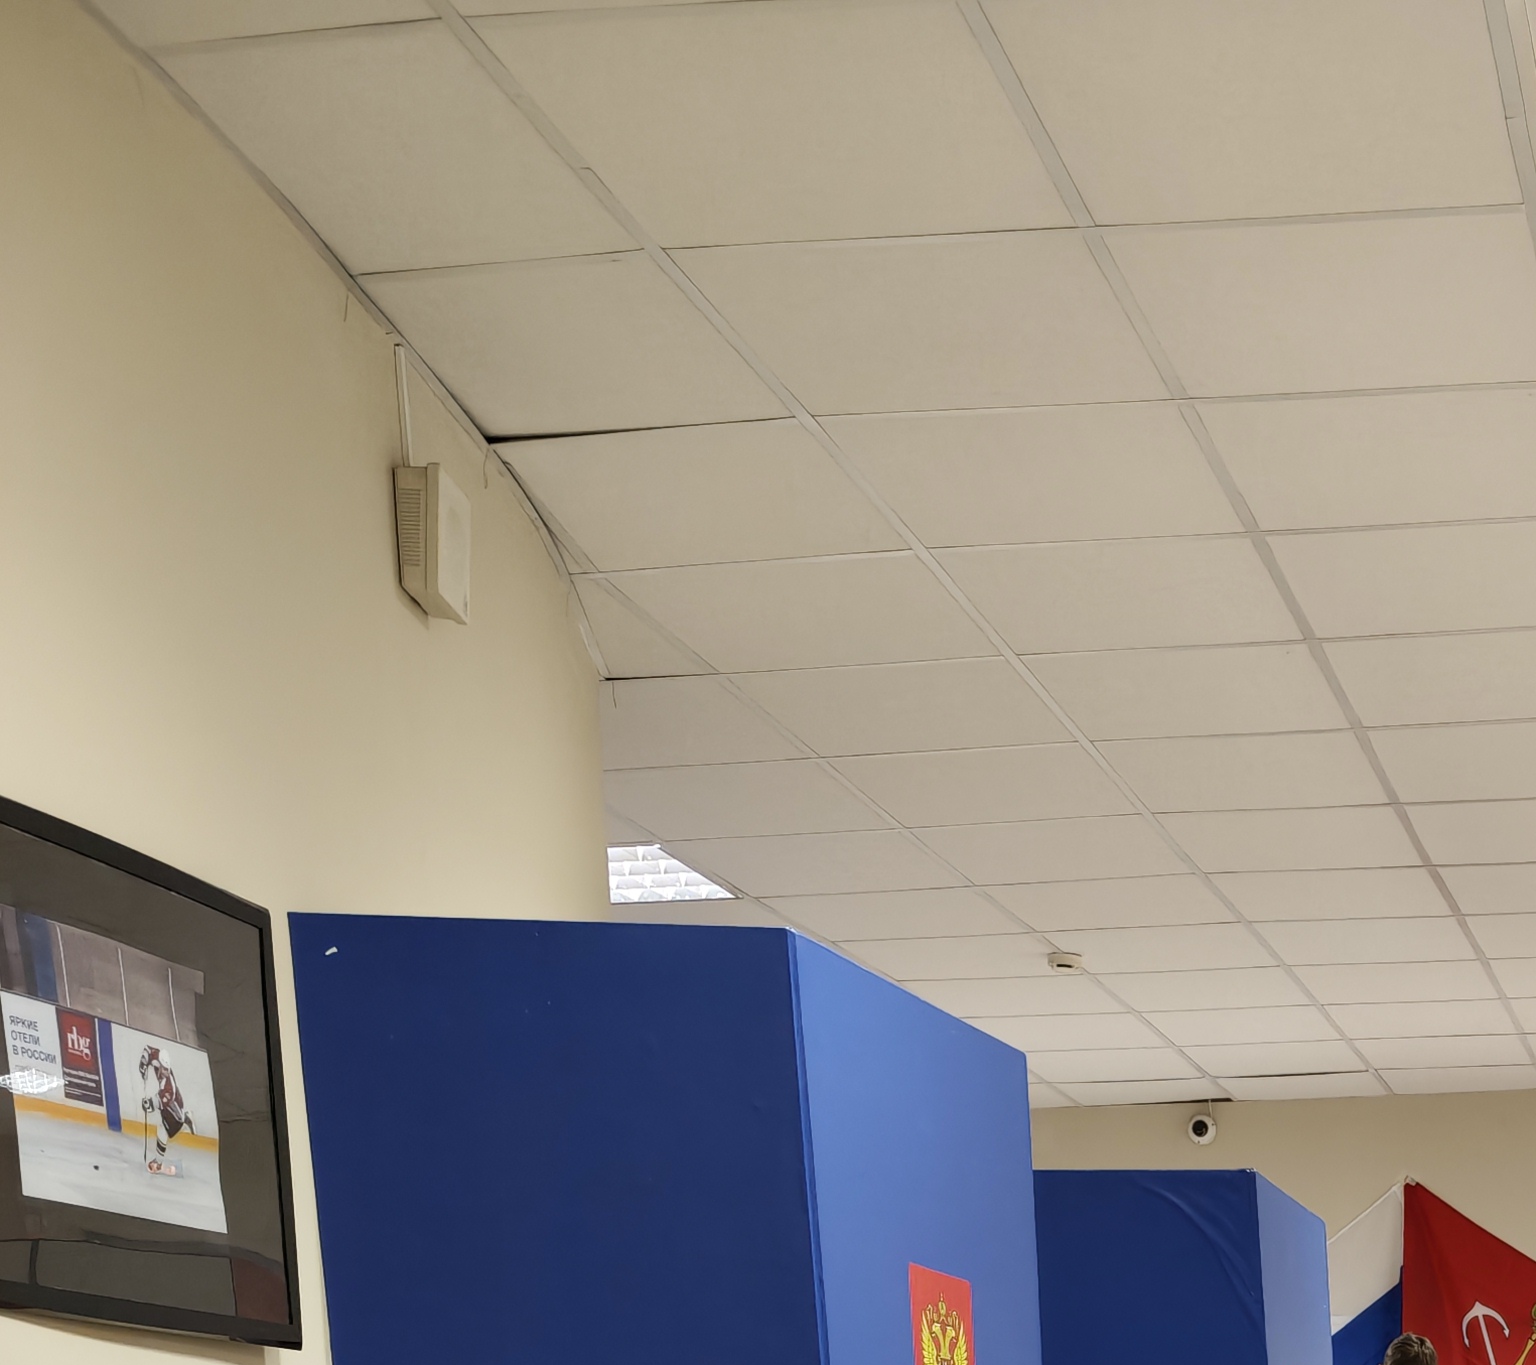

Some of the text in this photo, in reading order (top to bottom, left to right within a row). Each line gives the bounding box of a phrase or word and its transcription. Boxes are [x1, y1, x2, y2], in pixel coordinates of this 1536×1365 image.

[9, 1015, 39, 1032] ЯРКИЕ
[11, 1029, 40, 1046] ОТЕЛИ
[12, 1045, 57, 1065] В РОССИИ
